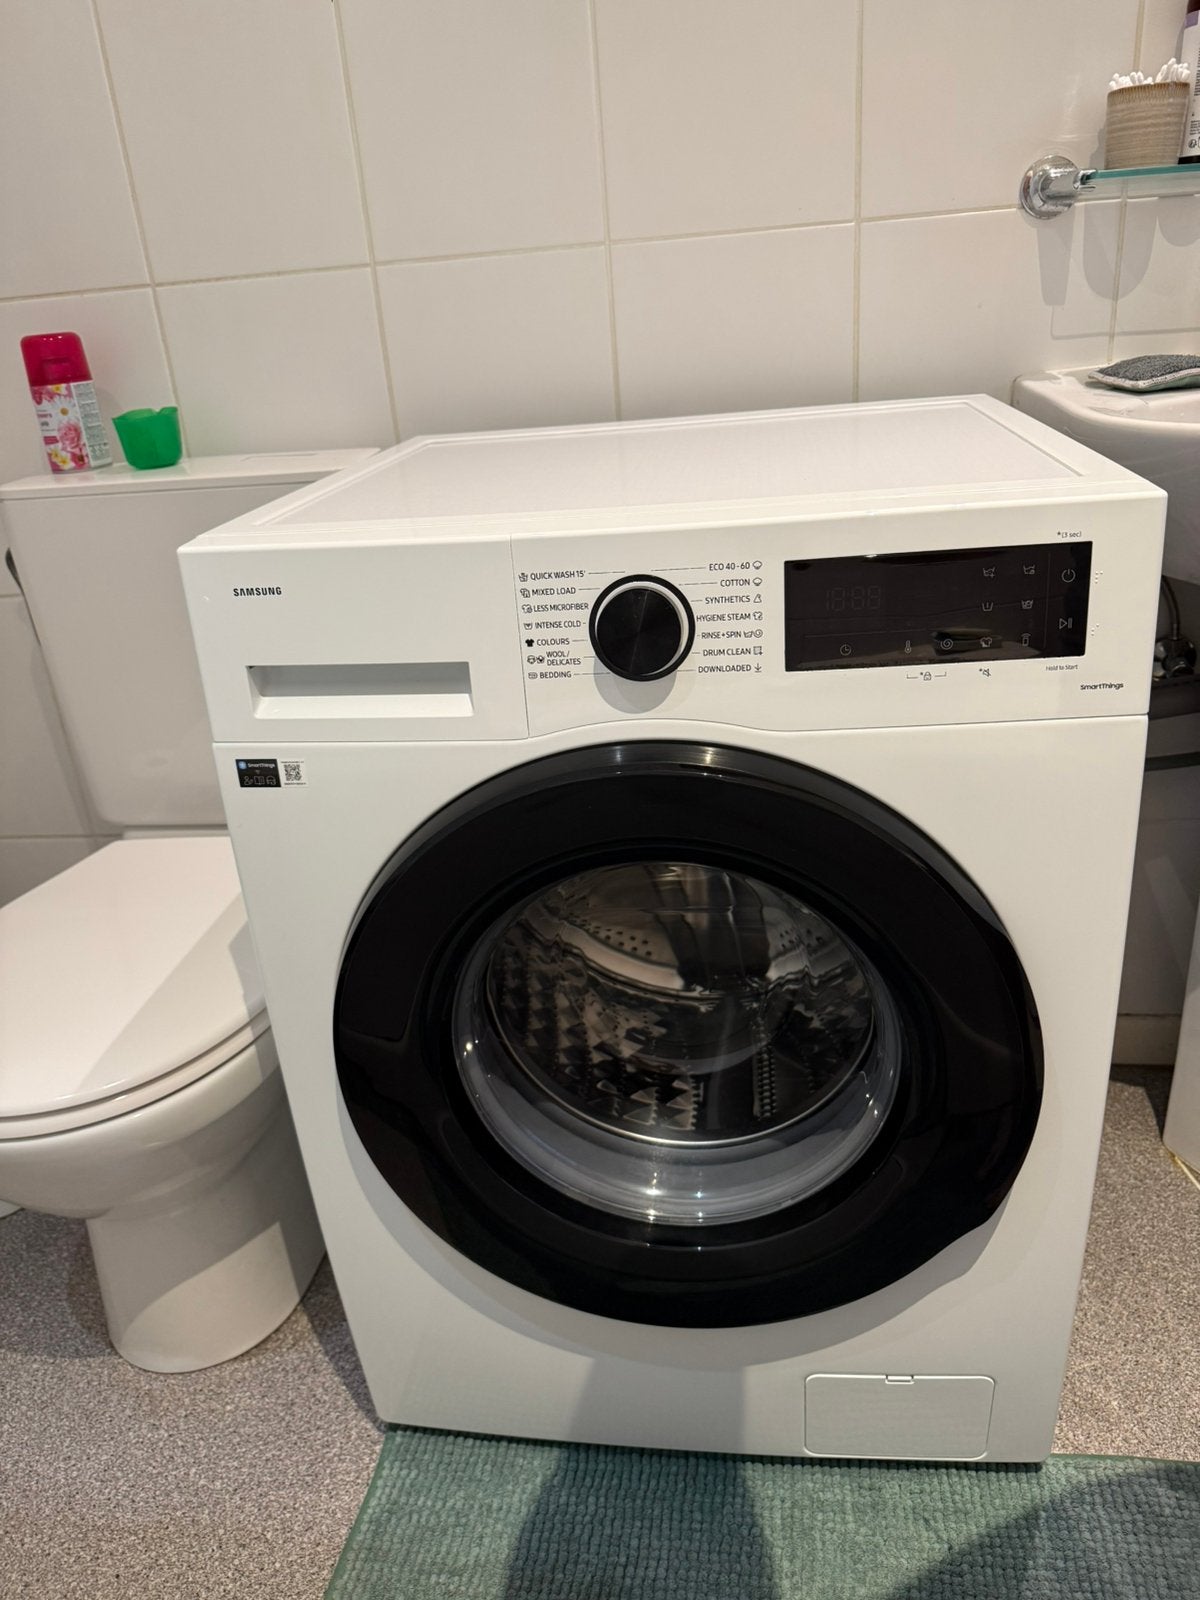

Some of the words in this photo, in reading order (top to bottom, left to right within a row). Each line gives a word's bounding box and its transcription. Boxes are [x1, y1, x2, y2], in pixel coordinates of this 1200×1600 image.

[709, 563, 724, 571] ECO
[530, 573, 553, 581] QUICK
[553, 570, 575, 579] WASH
[720, 578, 751, 587] COTTON
[233, 586, 282, 597] SAMSUNG
[532, 588, 555, 596] MIXED
[556, 587, 576, 595] LOAD
[705, 595, 751, 604] SYNTHETICS
[533, 604, 549, 613] LESS
[549, 602, 589, 611] MICROFIBER
[696, 613, 727, 622] HYGIENE
[727, 612, 751, 621] STEAM
[535, 621, 563, 629] INTENSE
[563, 620, 581, 628] COLD
[536, 638, 570, 646] COLOURS
[702, 649, 725, 657] DRUM
[726, 647, 751, 656] CLEAN
[546, 658, 581, 666] DELICATES
[698, 664, 752, 673] DOWNLOADED
[539, 671, 572, 679] BEDDING
[1080, 682, 1124, 690] SmartThings
